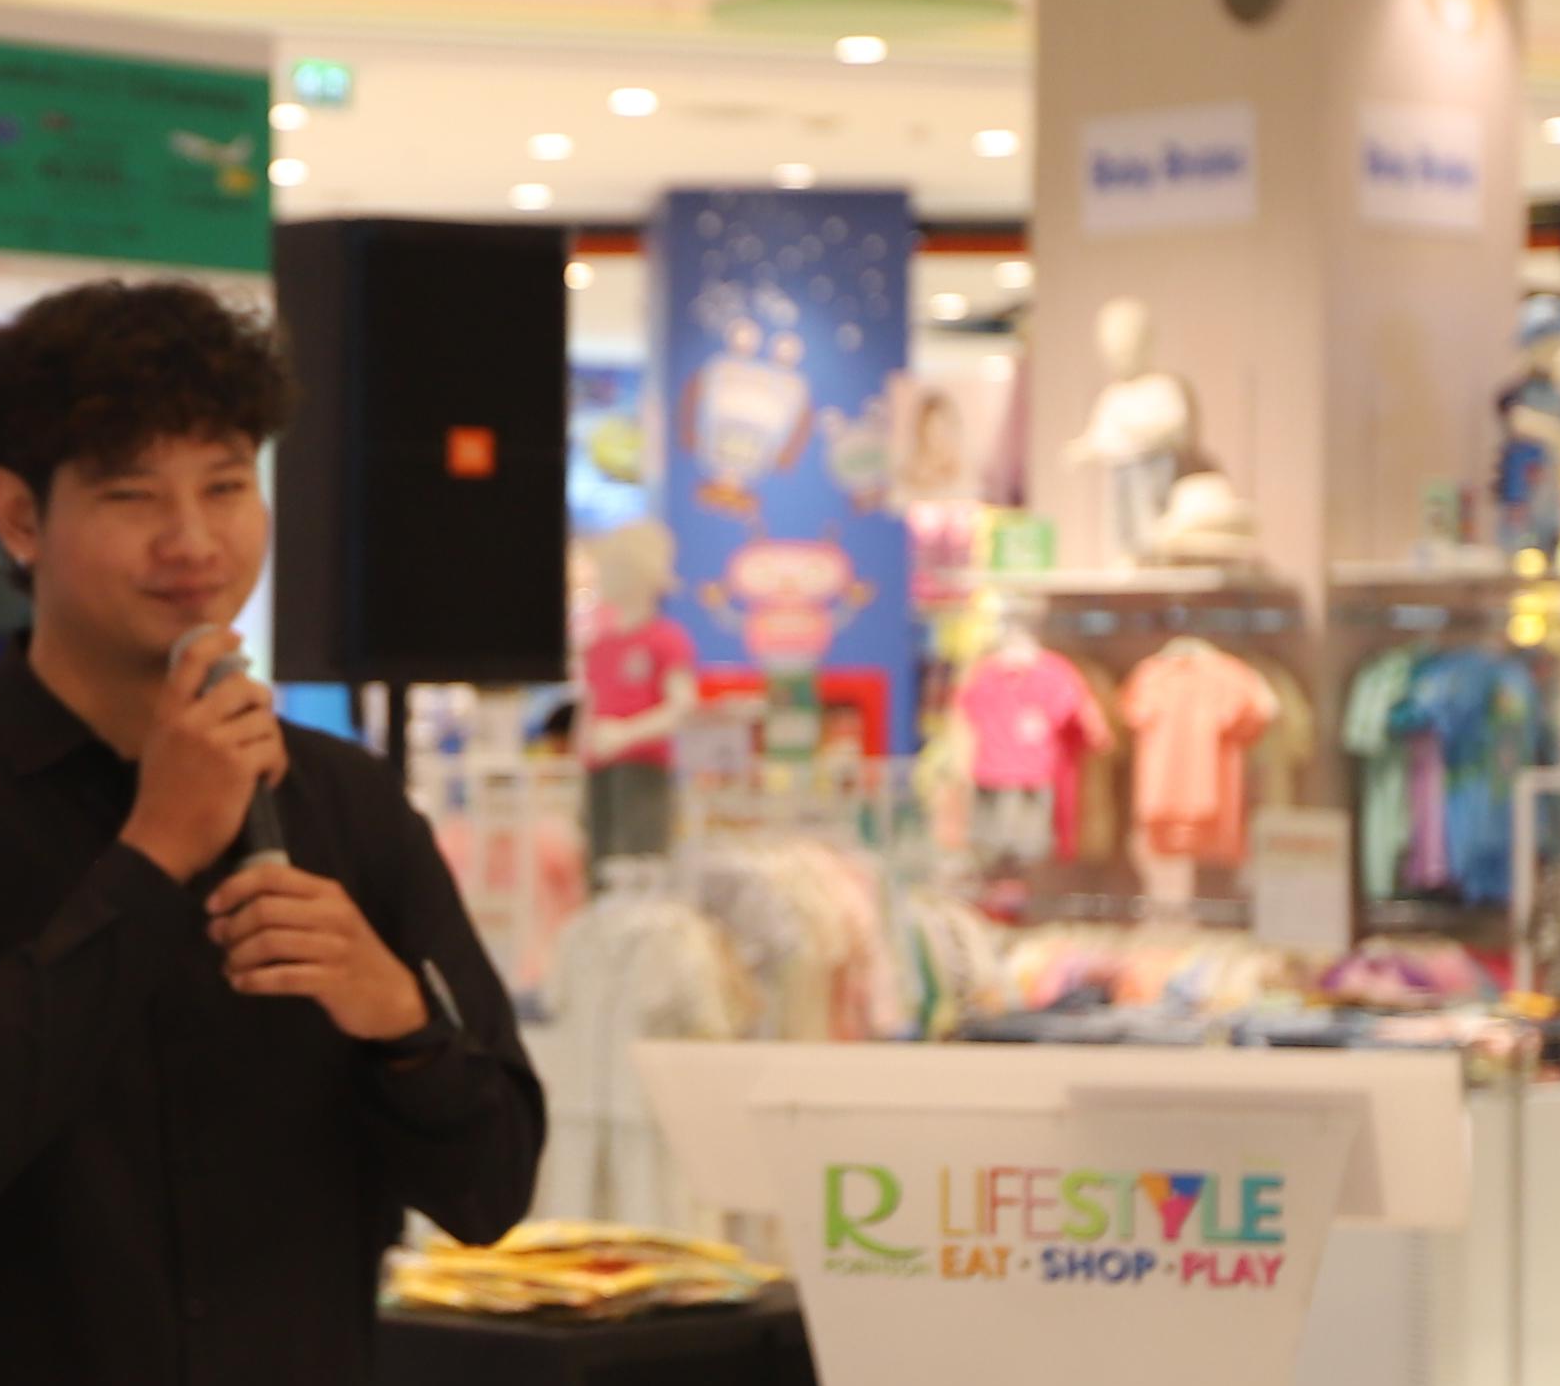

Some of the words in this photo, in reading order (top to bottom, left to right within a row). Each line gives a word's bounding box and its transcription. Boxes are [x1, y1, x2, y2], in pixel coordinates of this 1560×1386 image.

[825, 1163, 923, 1259] R
[938, 1163, 1286, 1245] LIFESTYLE
[940, 1244, 1012, 1282] EAT
[1039, 1246, 1158, 1284] SHOP
[1181, 1250, 1286, 1288] PLAY
